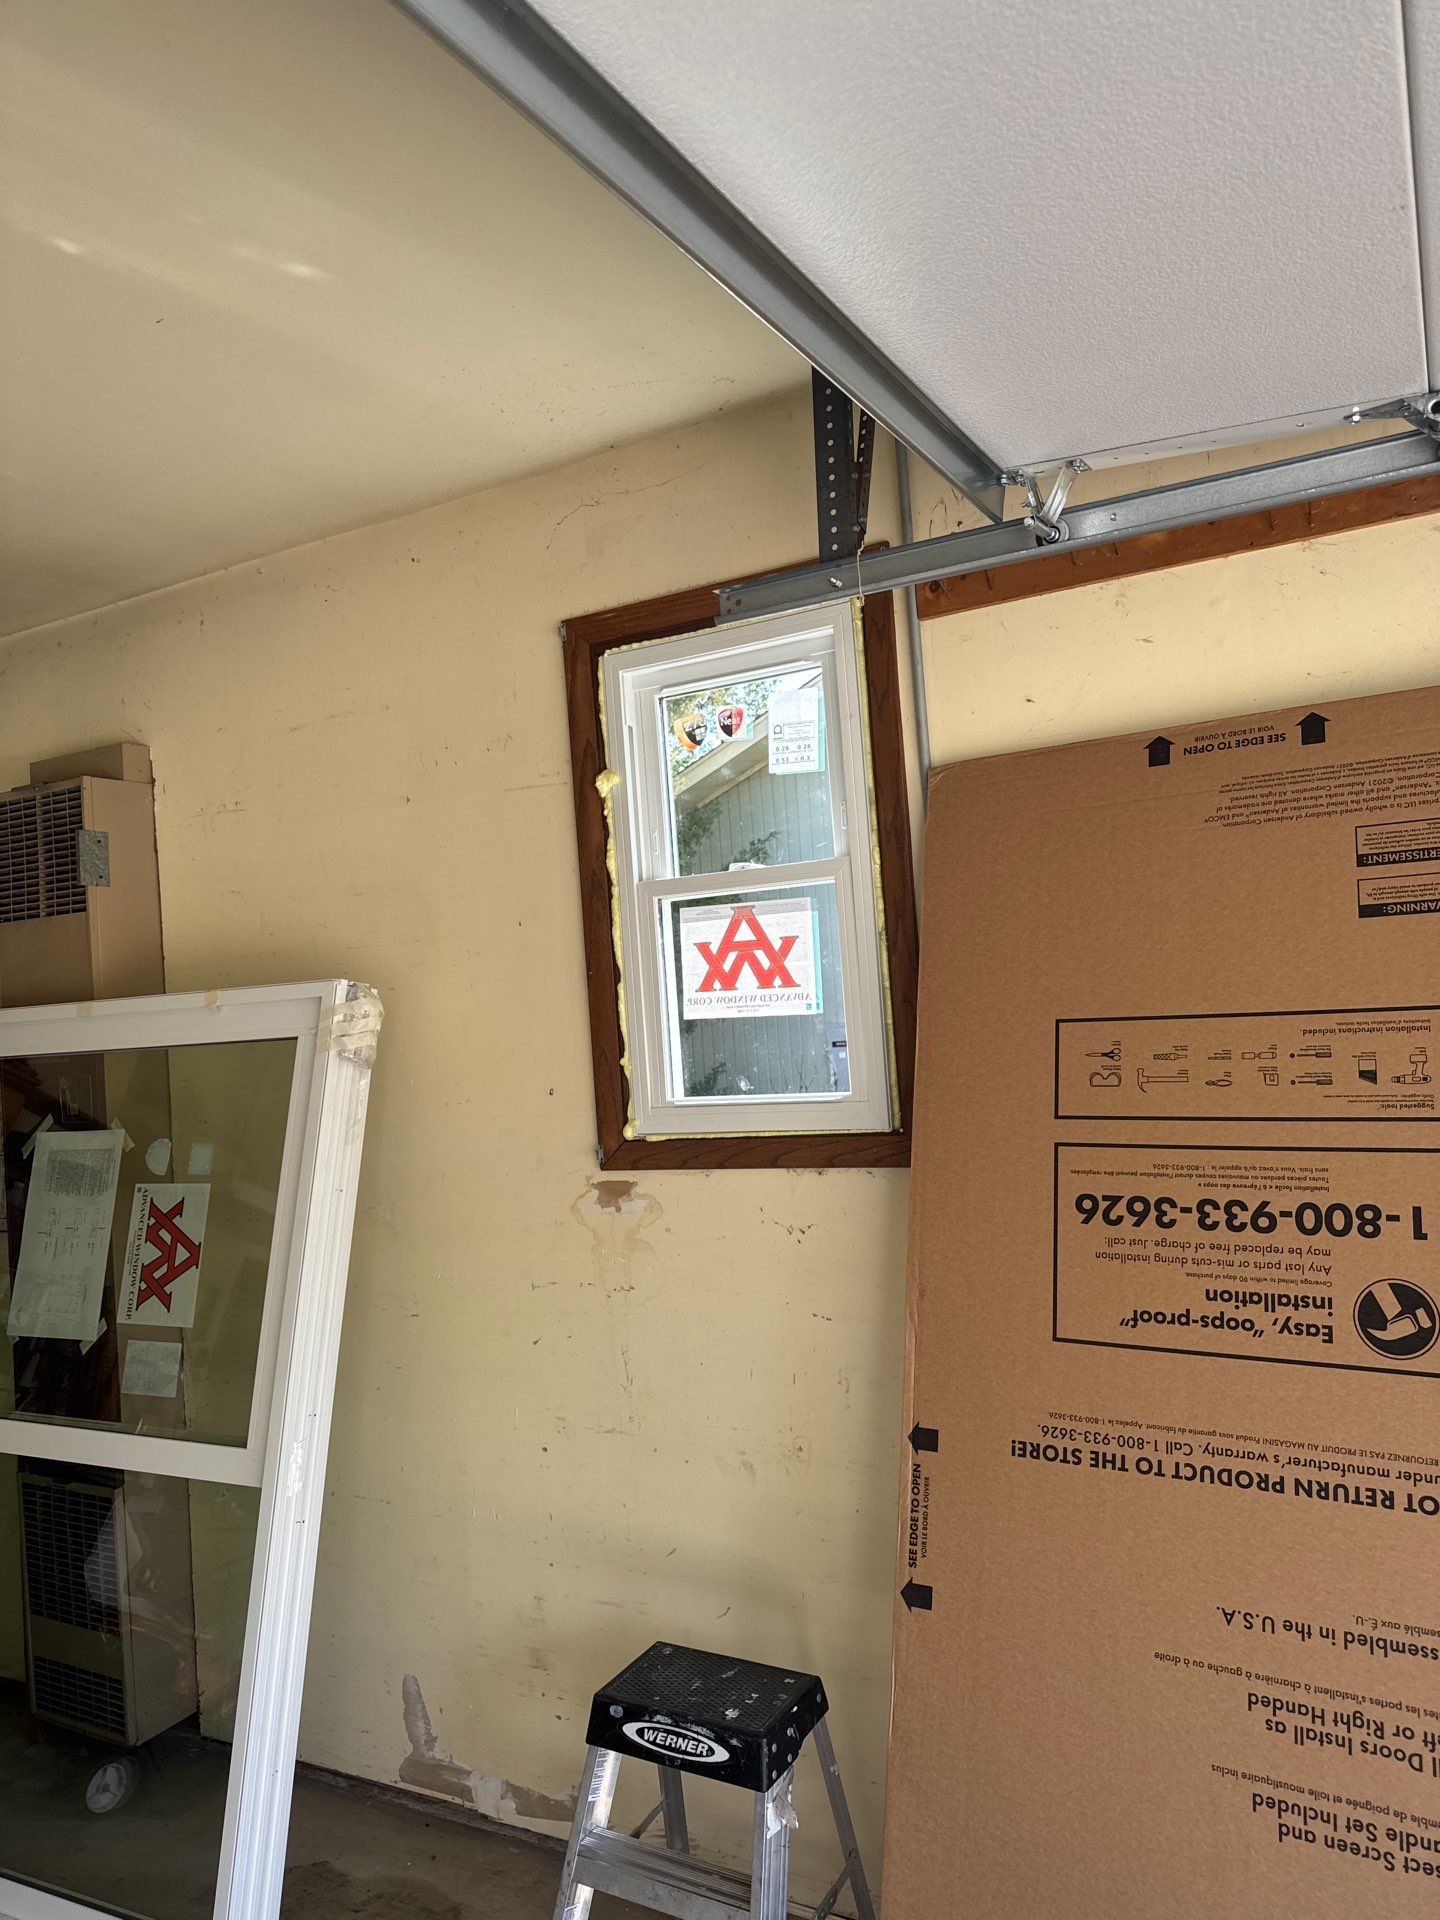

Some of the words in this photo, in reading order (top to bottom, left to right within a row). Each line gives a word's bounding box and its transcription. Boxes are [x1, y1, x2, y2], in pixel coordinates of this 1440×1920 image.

[721, 717, 740, 725] Neat
[1195, 734, 1219, 742] OUVRIR
[1228, 729, 1246, 737] BORD
[1267, 733, 1286, 743] SEE
[1217, 741, 1232, 750] TO
[1235, 736, 1264, 748] EDGE
[1184, 744, 1214, 756] OPEN
[1369, 778, 1394, 786] ©2021
[1229, 794, 1258, 803] reserved.
[1260, 791, 1277, 799] rights
[1362, 794, 1391, 803] supports
[1326, 800, 1348, 809] limited
[1232, 812, 1244, 820] and
[1246, 808, 1280, 818] Andersen®
[1304, 810, 1338, 818] subsidiary
[1340, 807, 1363, 816] owned
[1204, 814, 1230, 823] EMCO®
[1386, 1026, 1431, 1034] Installation
[1400, 1102, 1434, 1110] Suggested
[136, 1187, 149, 1241] ADVANCED
[1075, 1194, 1428, 1240] 1-800-933-3626
[1105, 1237, 1126, 1248] call:
[1129, 1239, 1148, 1249] Just
[1151, 1238, 1191, 1252] charge.
[1194, 1242, 1205, 1253] of
[1209, 1243, 1230, 1255] free
[1234, 1244, 1284, 1257] replaced
[1288, 1247, 1302, 1259] be
[1306, 1246, 1330, 1256] may
[1096, 1252, 1150, 1264] installation
[1154, 1253, 1188, 1268] during
[1192, 1258, 1234, 1269] mis-cuts
[130, 1244, 143, 1288] WINDOW
[1254, 1260, 1281, 1270] parts
[1285, 1264, 1304, 1275] lost
[1308, 1262, 1332, 1276] Any
[1222, 1274, 1237, 1282] days
[1278, 1278, 1298, 1286] limited
[1300, 1278, 1332, 1288] Coverage
[125, 1292, 136, 1320] CORP.
[1206, 1289, 1332, 1316] installation
[1272, 1316, 1333, 1344] Easy,
[1038, 1424, 1158, 1452] 1-800-933-3626.
[1263, 1438, 1305, 1450] MAGASIN!
[1012, 1440, 1082, 1465] STORE!
[1166, 1441, 1193, 1456] Call
[1199, 1442, 1268, 1462] warranty.
[1308, 1443, 1319, 1451] AU
[1321, 1445, 1356, 1456] PRODUIT
[1090, 1450, 1128, 1472] THE
[1370, 1451, 1385, 1459] PAS
[1387, 1453, 1438, 1466] RETOURNEZ
[1136, 1457, 1166, 1477] TO
[1274, 1454, 1390, 1478] manufacturer's
[912, 1463, 921, 1497] OPEN
[1172, 1462, 1284, 1494] PRODUCT
[1294, 1478, 1394, 1510] RETURN
[911, 1498, 919, 1515] TO
[1404, 1493, 1440, 1516] OT
[910, 1516, 918, 1546] EDGE
[922, 1531, 927, 1539] LE
[909, 1547, 917, 1568] SEE
[1216, 1607, 1275, 1634] U.S.A.
[1353, 1615, 1378, 1631] É.-U.
[1381, 1620, 1400, 1630] aux
[1283, 1620, 1312, 1642] the
[1320, 1626, 1336, 1646] in
[1154, 1652, 1181, 1666] droite
[1184, 1658, 1190, 1668] à
[1193, 1660, 1204, 1668] ou
[1208, 1663, 1242, 1676] gauche
[1246, 1671, 1252, 1681] à
[1255, 1674, 1301, 1692] charnière
[1304, 1684, 1311, 1694] à
[1314, 1686, 1367, 1705] s'installent
[1248, 1692, 1325, 1726] Handed
[1369, 1698, 1402, 1710] portes
[1406, 1705, 1420, 1718] les
[1265, 1719, 1286, 1734] as
[1332, 1710, 1384, 1740] Right
[1392, 1725, 1414, 1740] or
[643, 1728, 710, 1756] WERNER
[1294, 1725, 1352, 1756] Install
[1360, 1740, 1423, 1772] Doors
[1212, 1764, 1238, 1780] inclus
[1242, 1772, 1304, 1794] moustiquaire
[1308, 1788, 1330, 1802] toile
[1333, 1795, 1342, 1804] et
[1252, 1793, 1337, 1832] Included
[1346, 1798, 1390, 1815] poignée
[1393, 1810, 1407, 1823] de
[1278, 1822, 1316, 1843] and
[1345, 1817, 1377, 1842] Set
[1324, 1835, 1396, 1871] Screen
